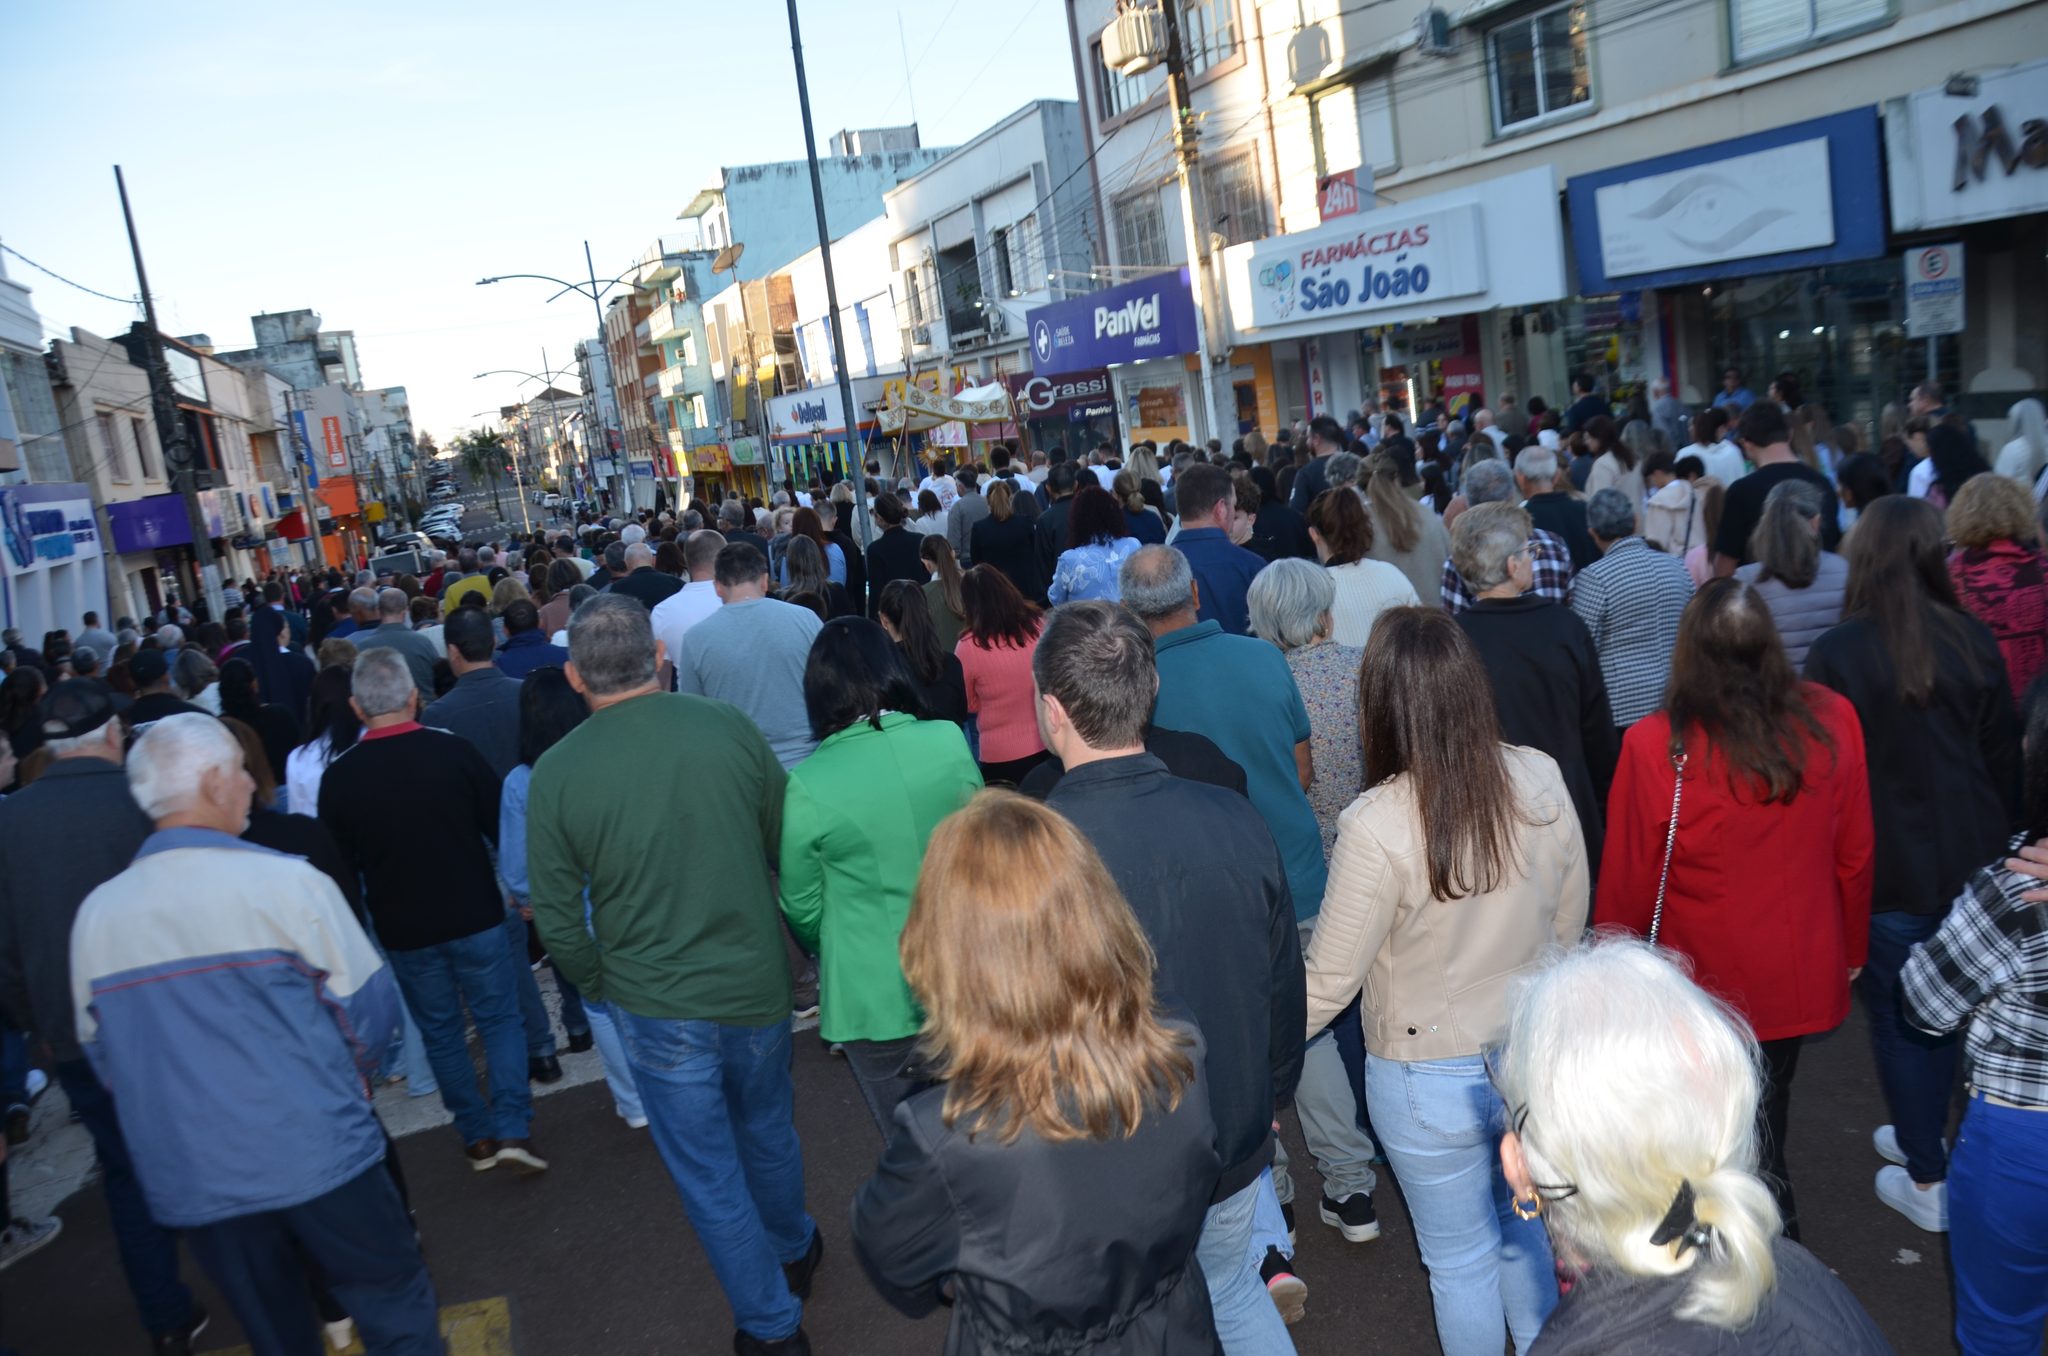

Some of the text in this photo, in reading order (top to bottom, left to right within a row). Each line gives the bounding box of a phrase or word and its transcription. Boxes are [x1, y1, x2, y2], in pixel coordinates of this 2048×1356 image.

[1323, 176, 1355, 214] 24h
[1301, 224, 1429, 270] FARMÁCIAS
[1300, 251, 1430, 311] São João
[1095, 293, 1160, 339] PanVel
[1024, 374, 1107, 410] Grassi
